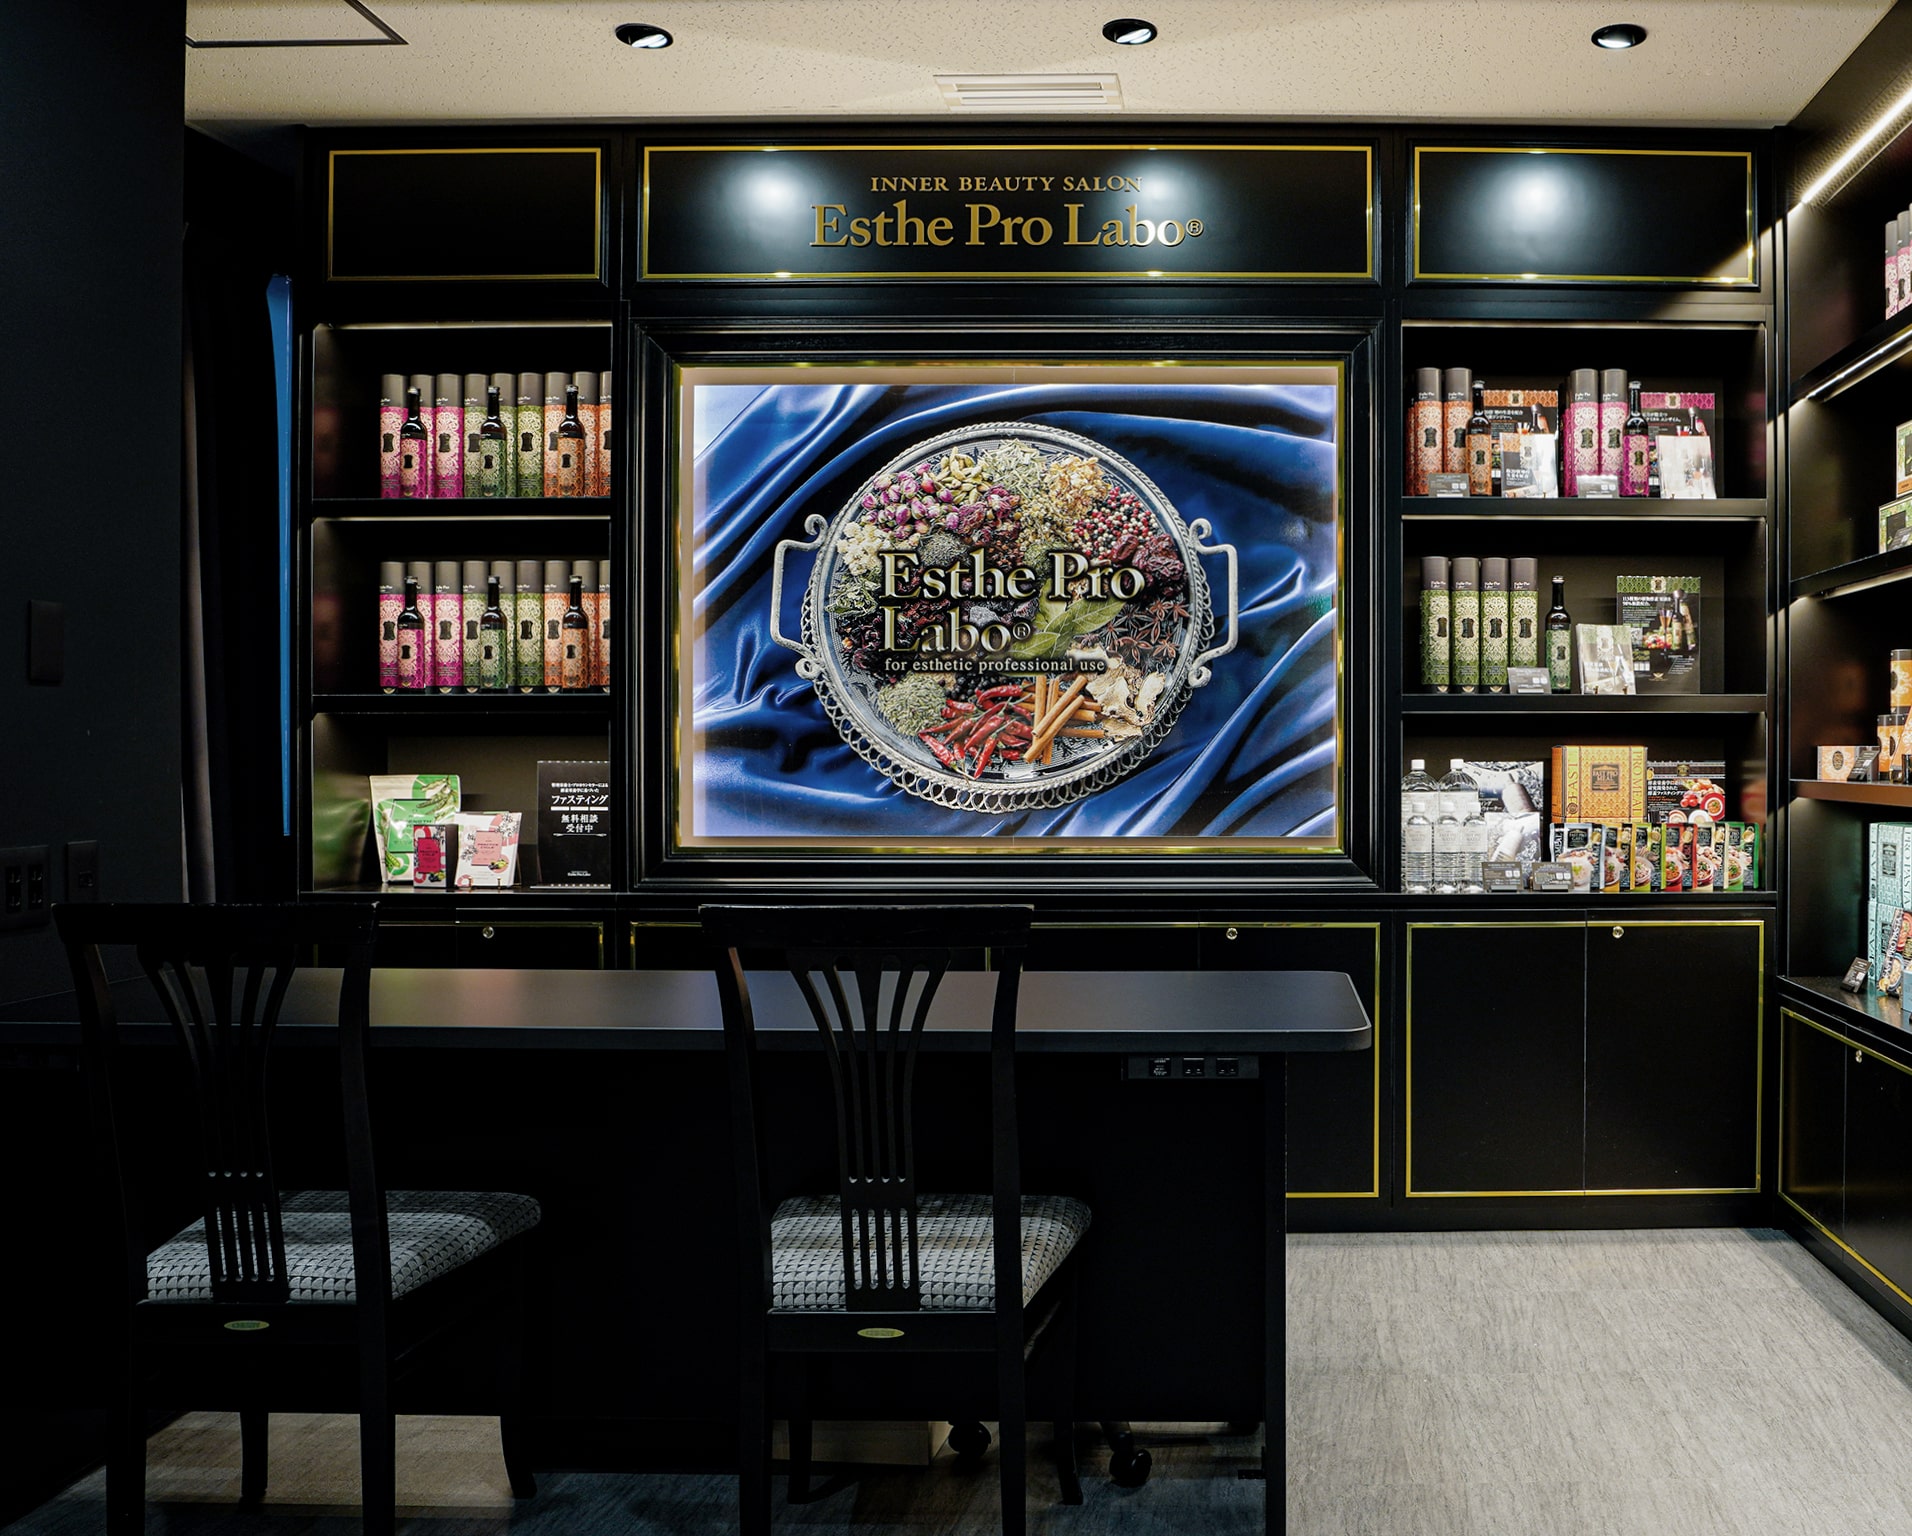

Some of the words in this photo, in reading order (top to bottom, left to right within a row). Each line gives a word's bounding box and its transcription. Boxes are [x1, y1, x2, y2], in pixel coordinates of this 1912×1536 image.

[870, 176, 949, 192] INNER
[958, 176, 1055, 192] BEAUTY
[1063, 175, 1143, 192] SALON
[810, 200, 954, 247] Esthe
[965, 203, 1053, 246] Pro
[878, 548, 1037, 600] Esthe
[1048, 552, 1146, 600] Pro
[884, 658, 906, 671] for
[912, 658, 972, 671] esthetic
[979, 658, 1074, 674] professional
[1079, 660, 1105, 671] use
[1567, 760, 1578, 803] FAST
[551, 795, 609, 805] ファスティング
[561, 814, 599, 823] 無料相談
[565, 824, 594, 833] 受付中
